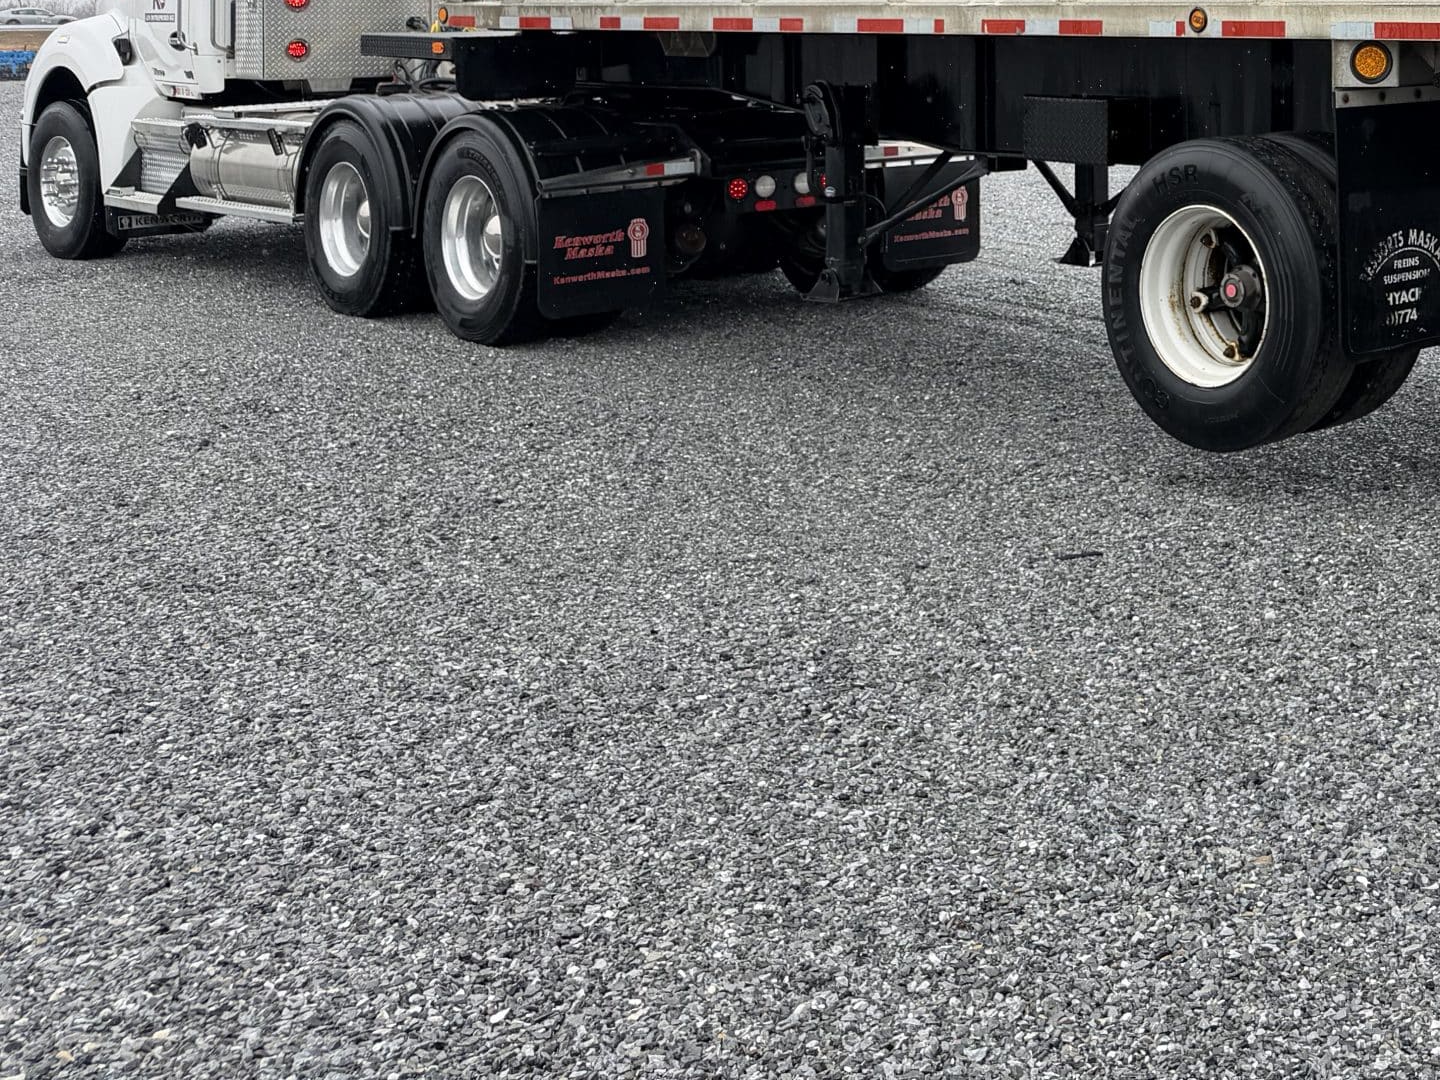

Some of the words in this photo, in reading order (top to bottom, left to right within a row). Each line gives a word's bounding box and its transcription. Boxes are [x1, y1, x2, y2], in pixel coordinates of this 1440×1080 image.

[1152, 164, 1200, 194] HSR
[553, 229, 626, 250] Kenworth
[564, 245, 615, 261] Maska
[1393, 256, 1421, 270] FREINS
[552, 266, 651, 286] KenworthMaska.com
